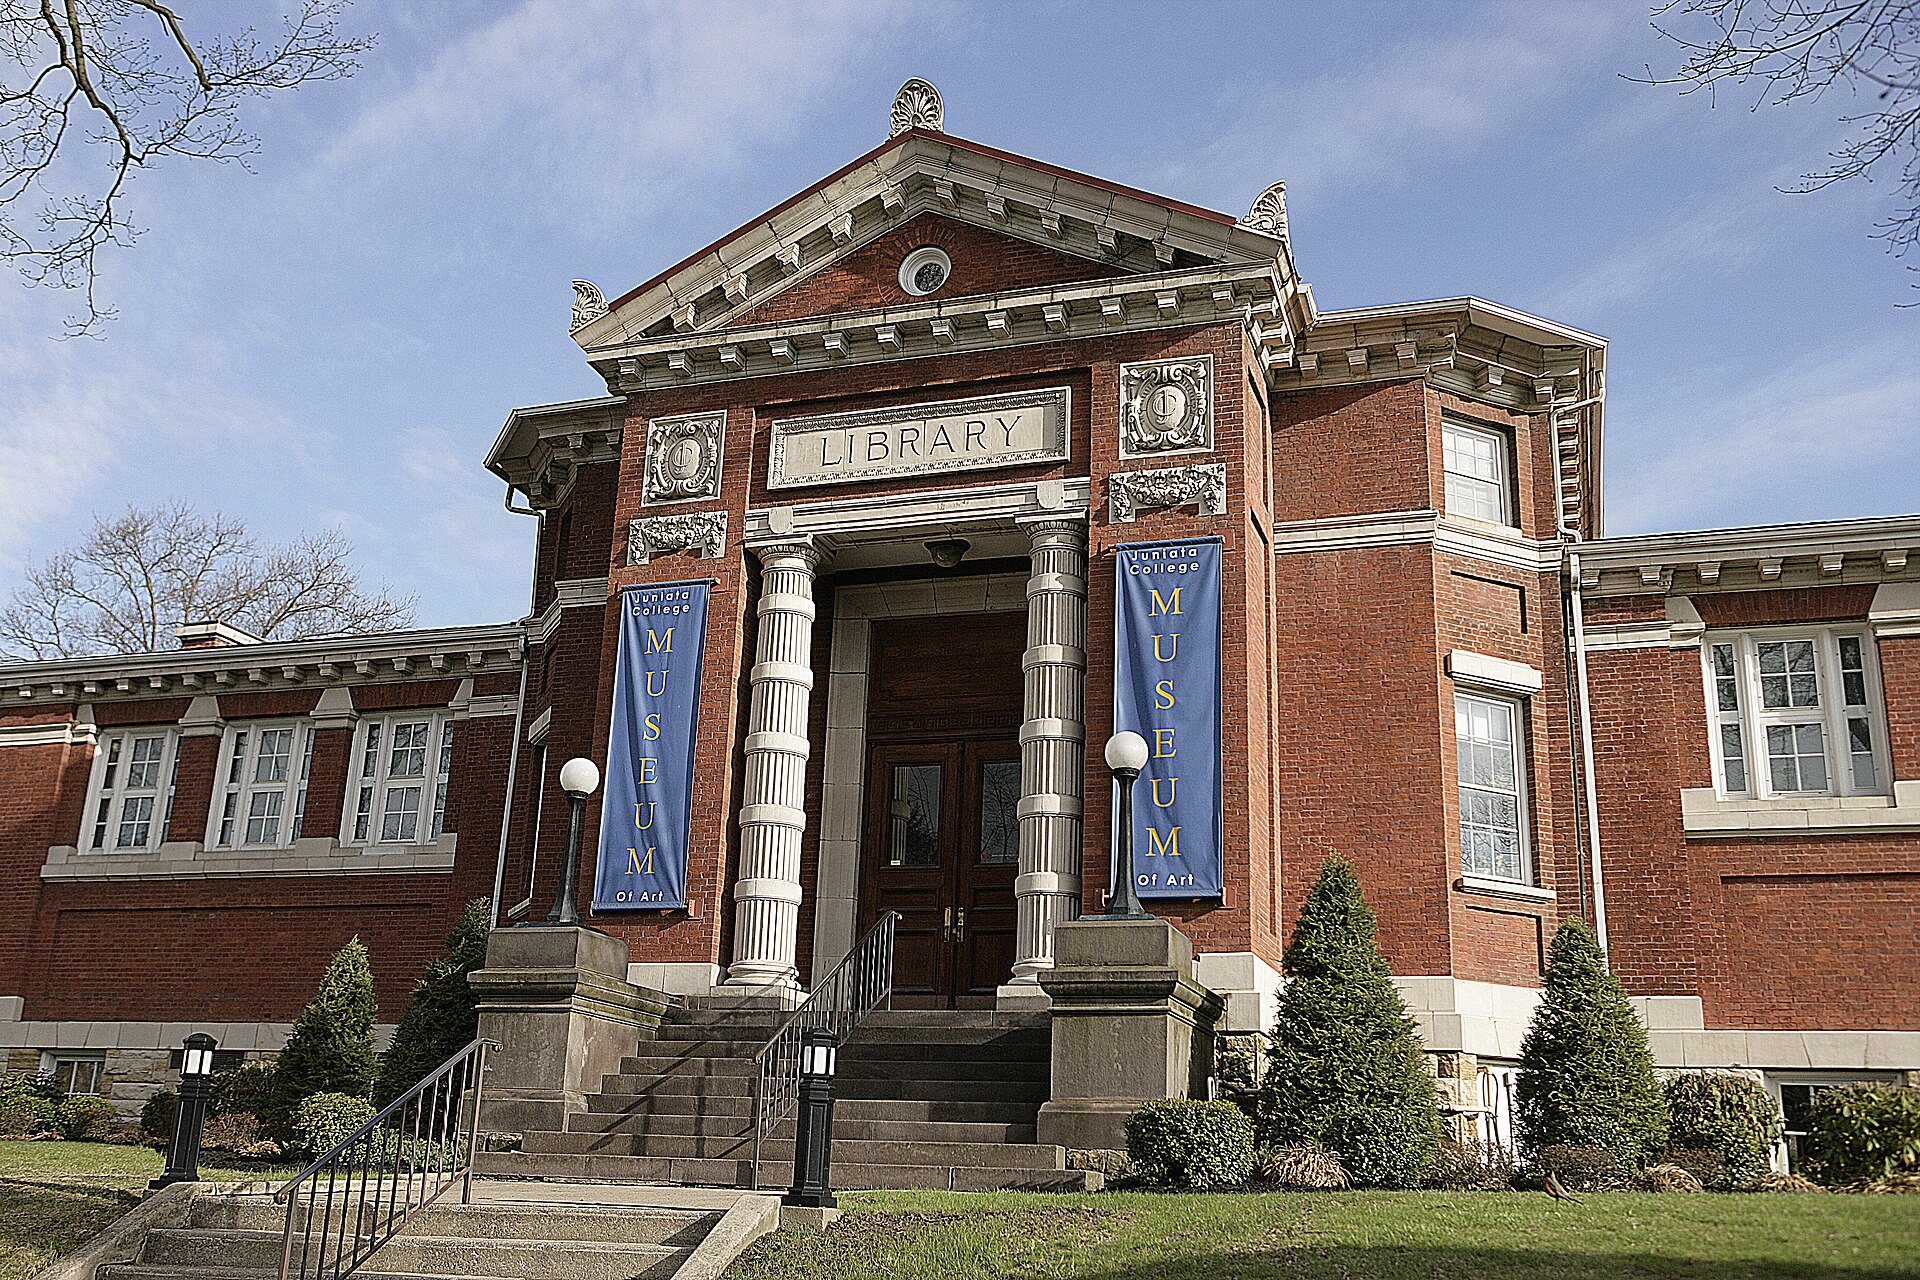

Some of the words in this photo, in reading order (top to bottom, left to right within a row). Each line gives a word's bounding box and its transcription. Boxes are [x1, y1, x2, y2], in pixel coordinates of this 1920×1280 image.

[821, 415, 1022, 467] LIBRARY
[1131, 546, 1197, 561] Juniata
[1129, 562, 1199, 575] College
[632, 604, 690, 616] College
[1145, 587, 1184, 857] MUSEUM
[624, 627, 675, 875] MUSEUM
[1137, 873, 1158, 886] Of
[1166, 873, 1194, 886] Art
[616, 891, 634, 902] Of
[640, 890, 664, 902] Art
